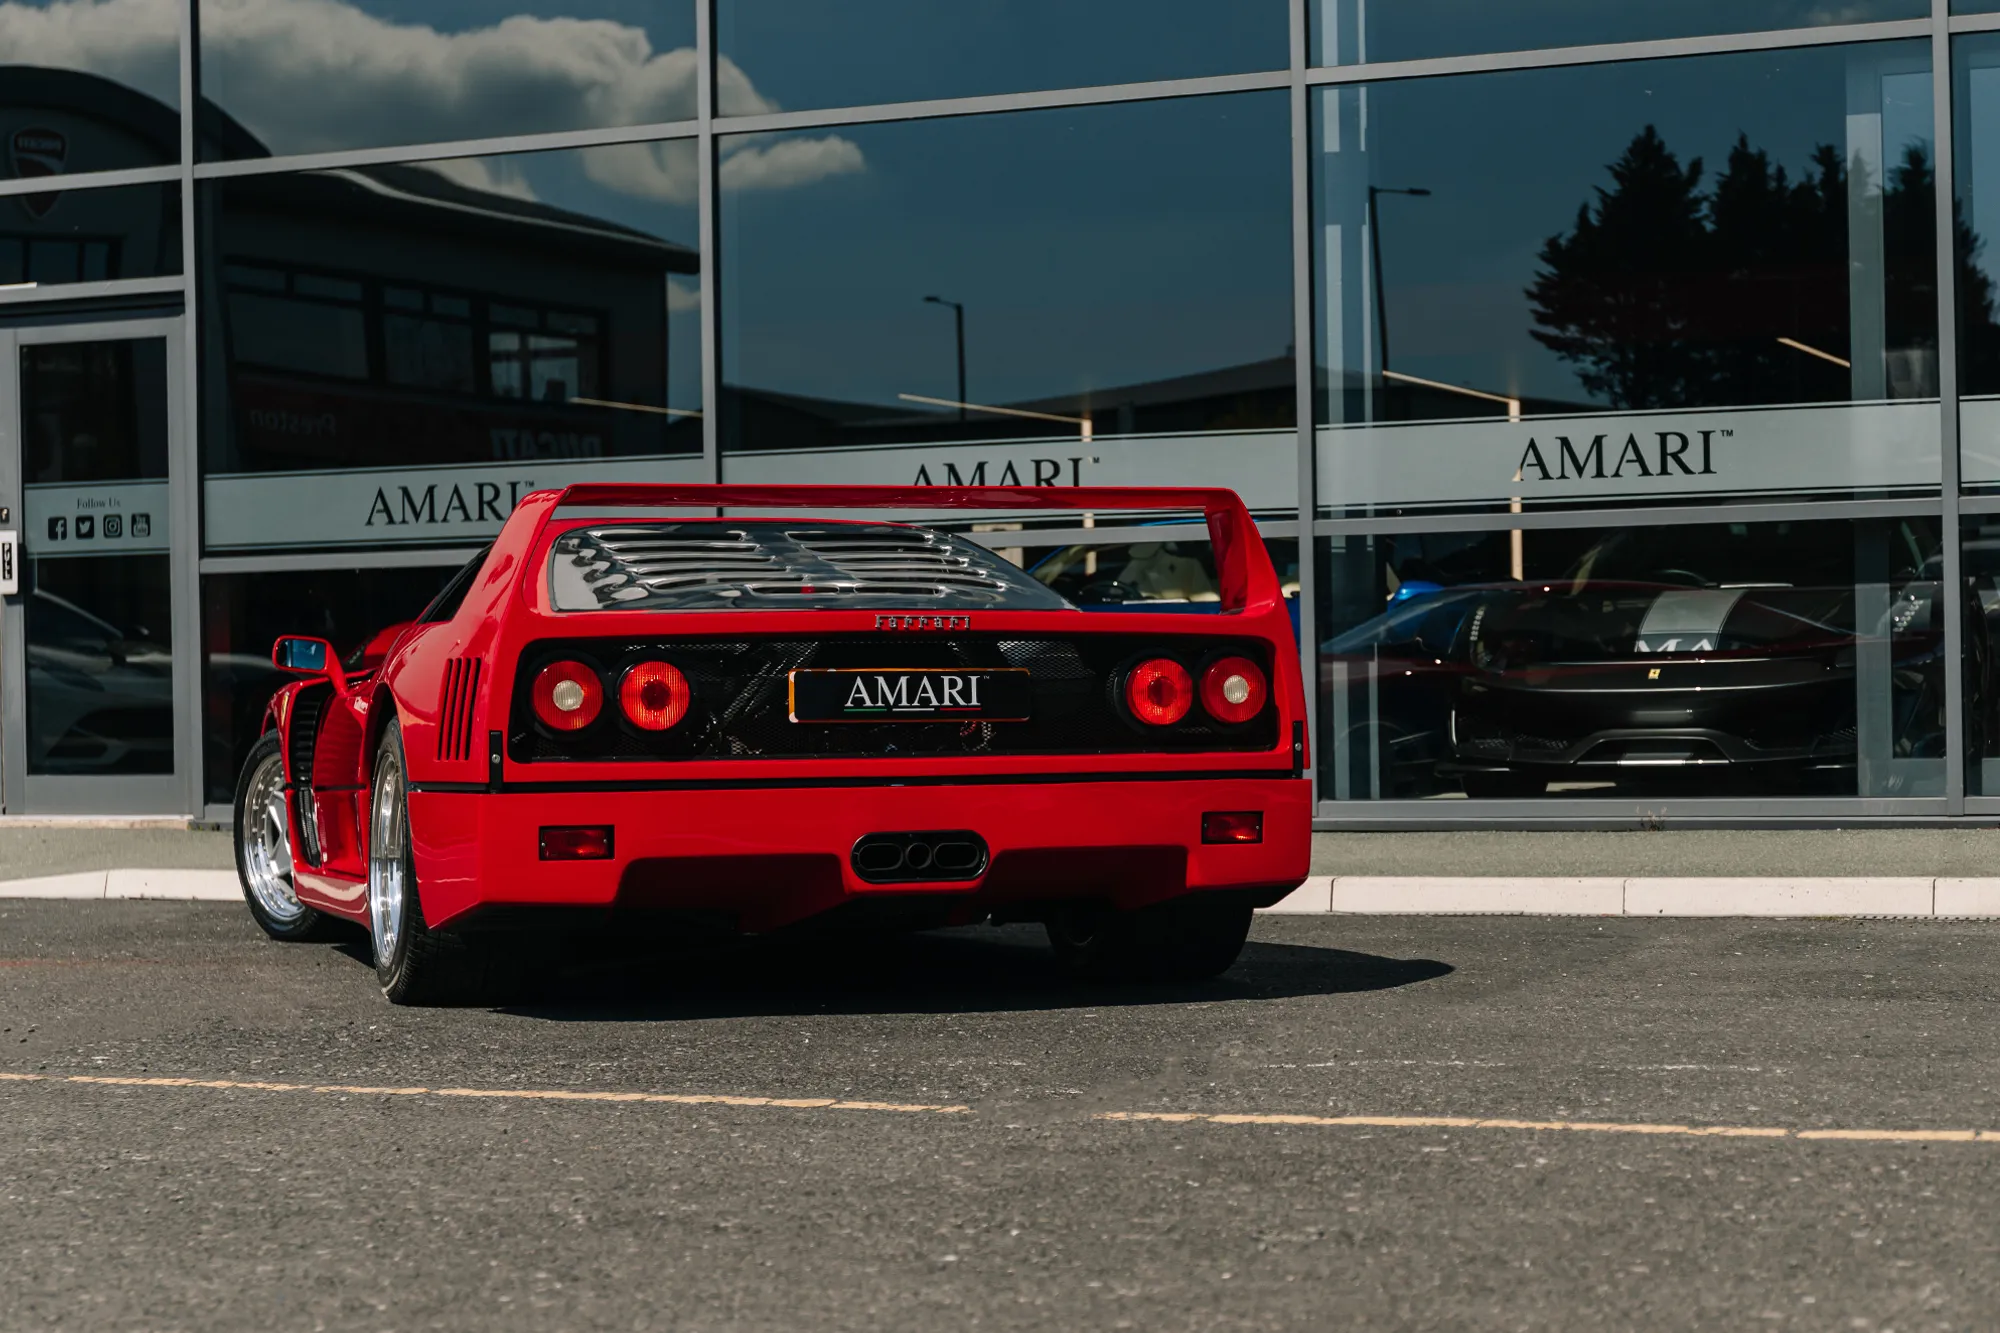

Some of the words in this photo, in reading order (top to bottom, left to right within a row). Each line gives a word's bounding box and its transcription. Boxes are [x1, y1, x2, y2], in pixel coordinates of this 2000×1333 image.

[1512, 430, 1717, 481] AMARI
[76, 498, 106, 509] Follow
[109, 497, 121, 508] Us
[365, 481, 520, 526] AMARI
[3, 543, 12, 579] PULL
[875, 614, 970, 629] Ferrari
[844, 675, 981, 707] AMARI
